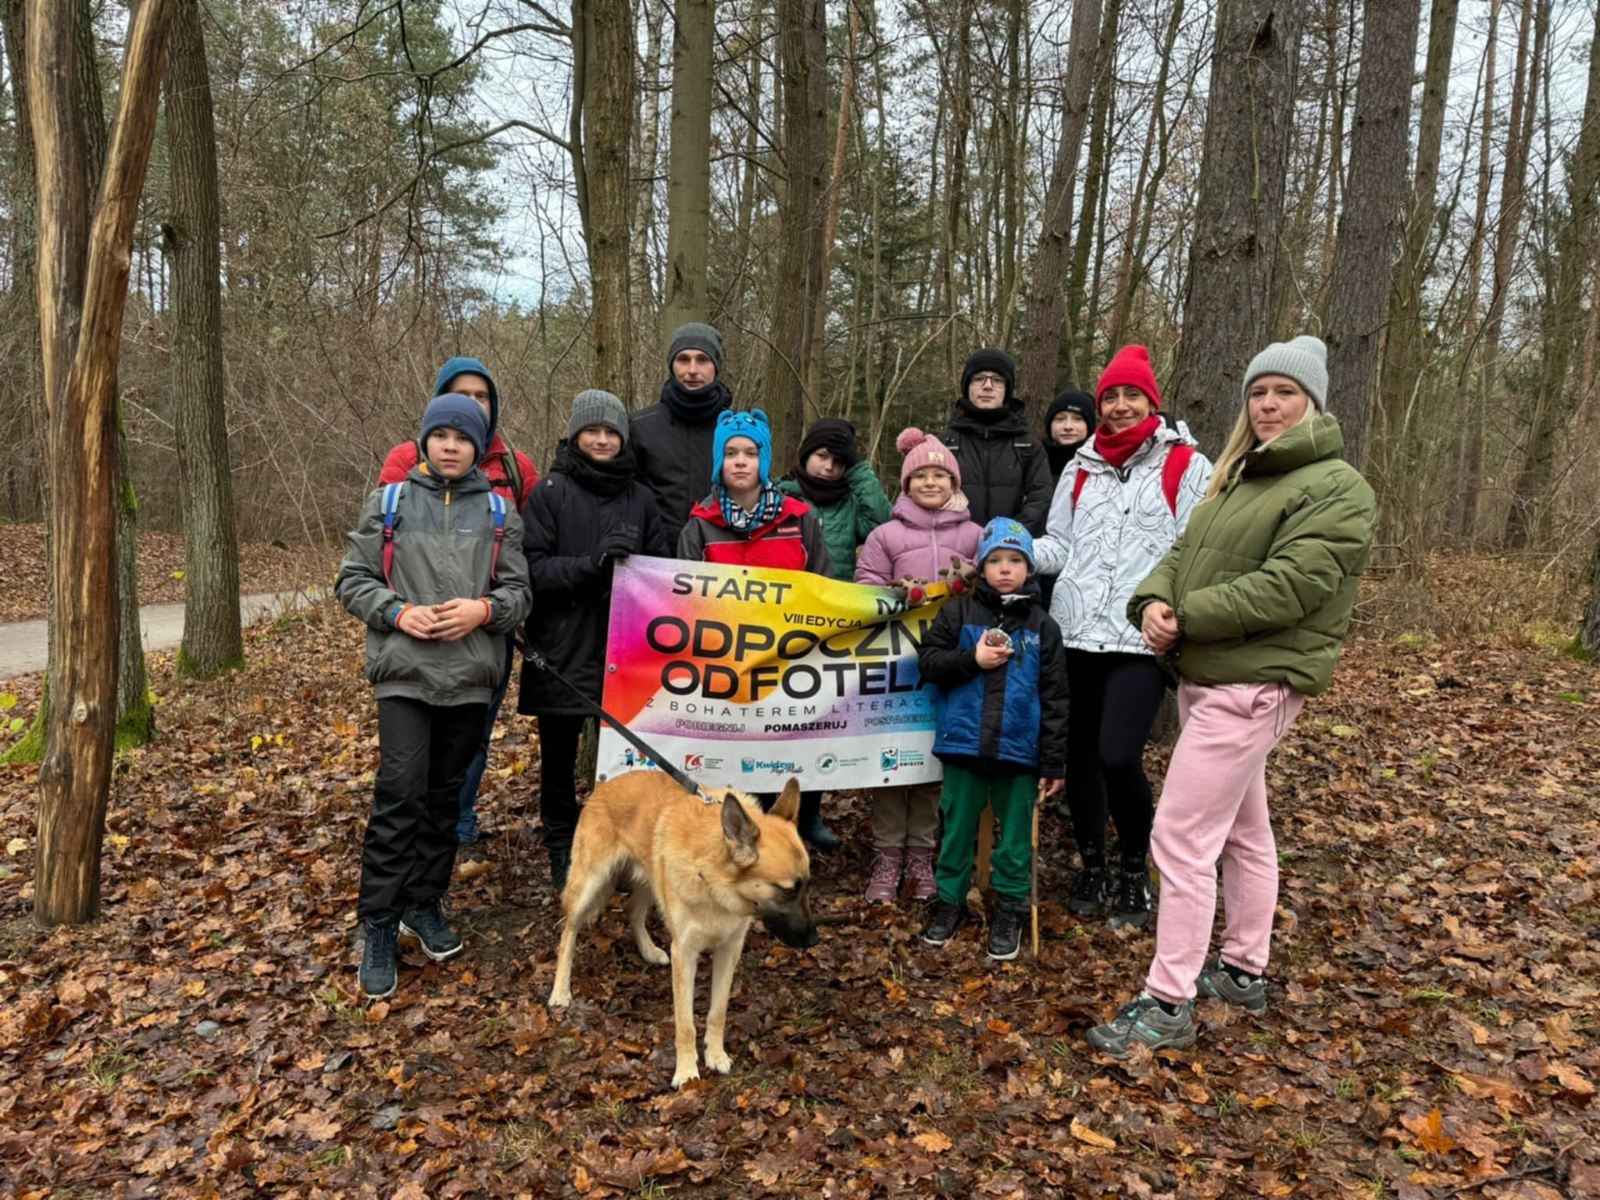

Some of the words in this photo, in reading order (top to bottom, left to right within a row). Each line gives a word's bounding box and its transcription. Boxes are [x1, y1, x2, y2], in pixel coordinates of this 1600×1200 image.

[671, 573, 792, 605] START
[783, 612, 804, 624] VIII
[806, 615, 862, 629] EDYCJA
[646, 616, 928, 661] ODPOCZN
[660, 660, 739, 700] OD
[750, 660, 923, 701] FOTEL
[646, 698, 654, 708] Z
[670, 701, 816, 717] BOHATEREM
[832, 697, 923, 713] LITERAC
[764, 720, 847, 733] POMASZERUJ
